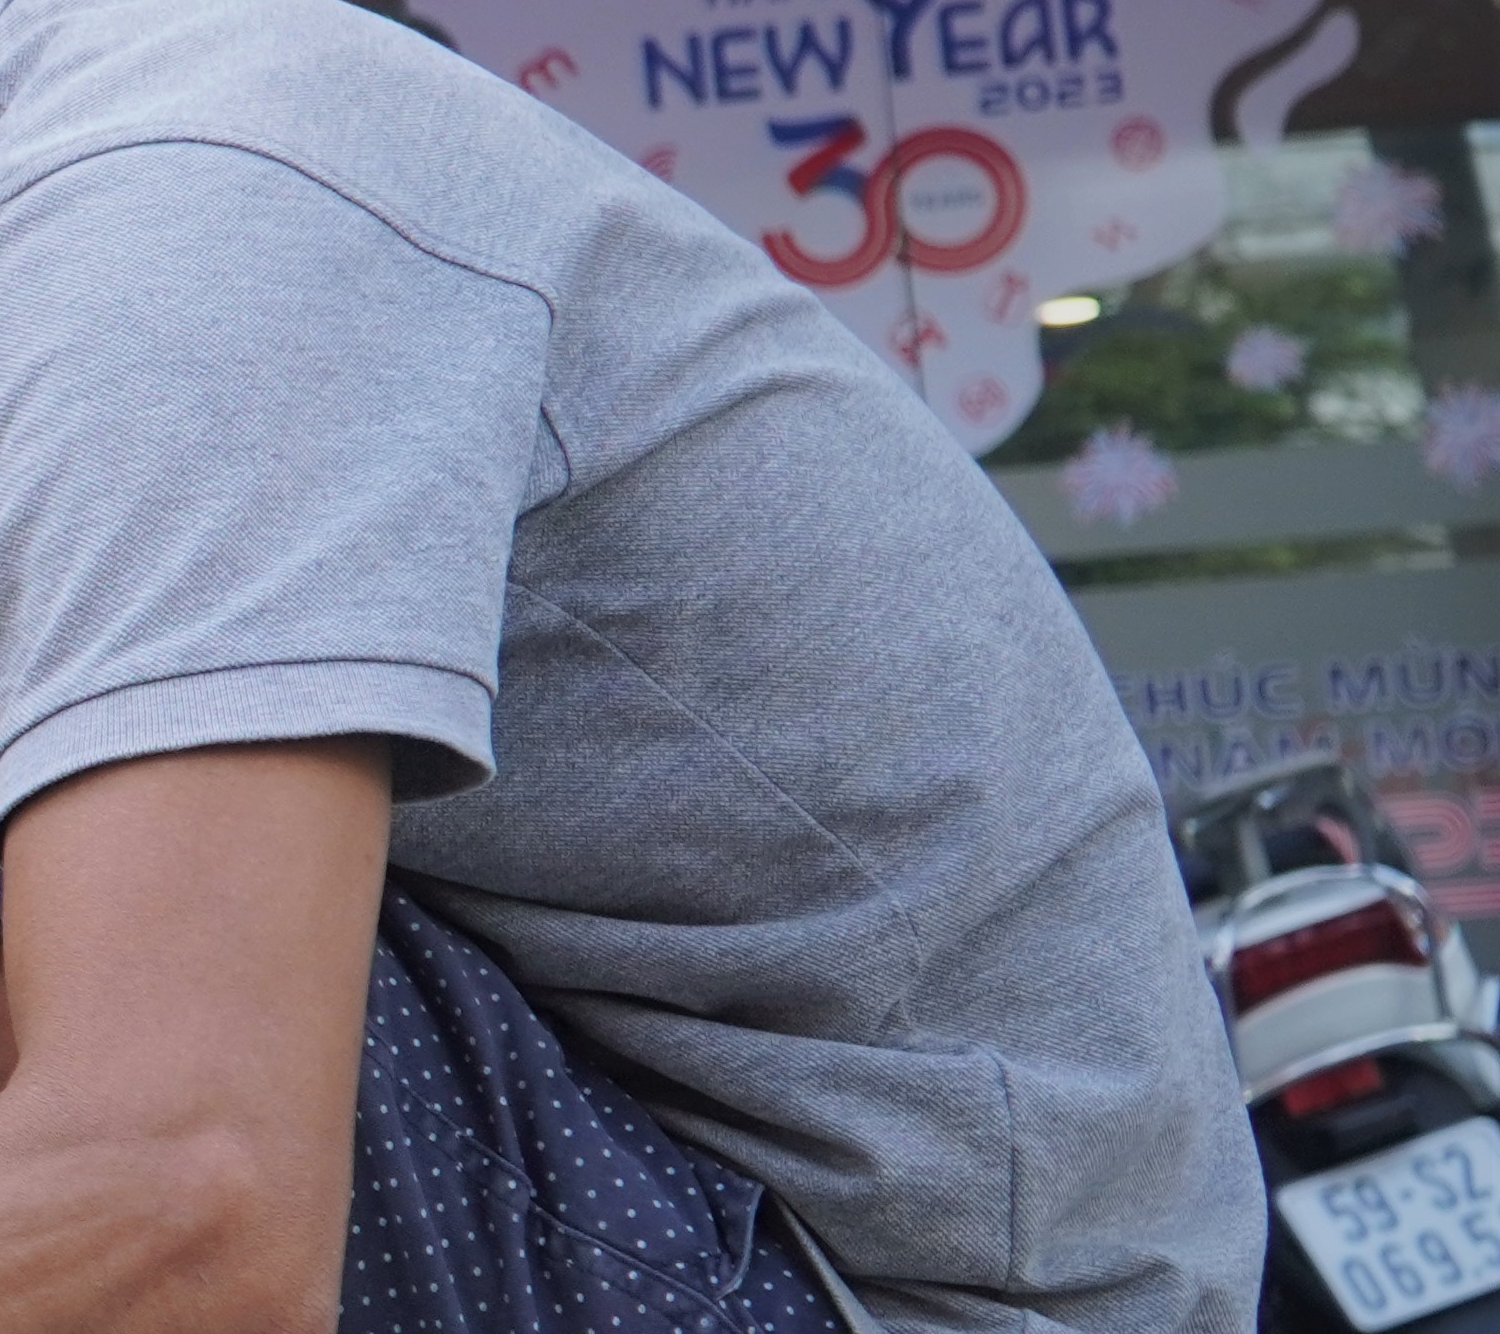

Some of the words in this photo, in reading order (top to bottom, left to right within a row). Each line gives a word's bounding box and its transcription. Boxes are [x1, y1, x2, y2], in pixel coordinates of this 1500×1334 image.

[640, 15, 853, 113] NEW
[978, 69, 1123, 117] 2023
[762, 114, 1028, 287] 30
[1319, 1141, 1492, 1244] 59-S2
